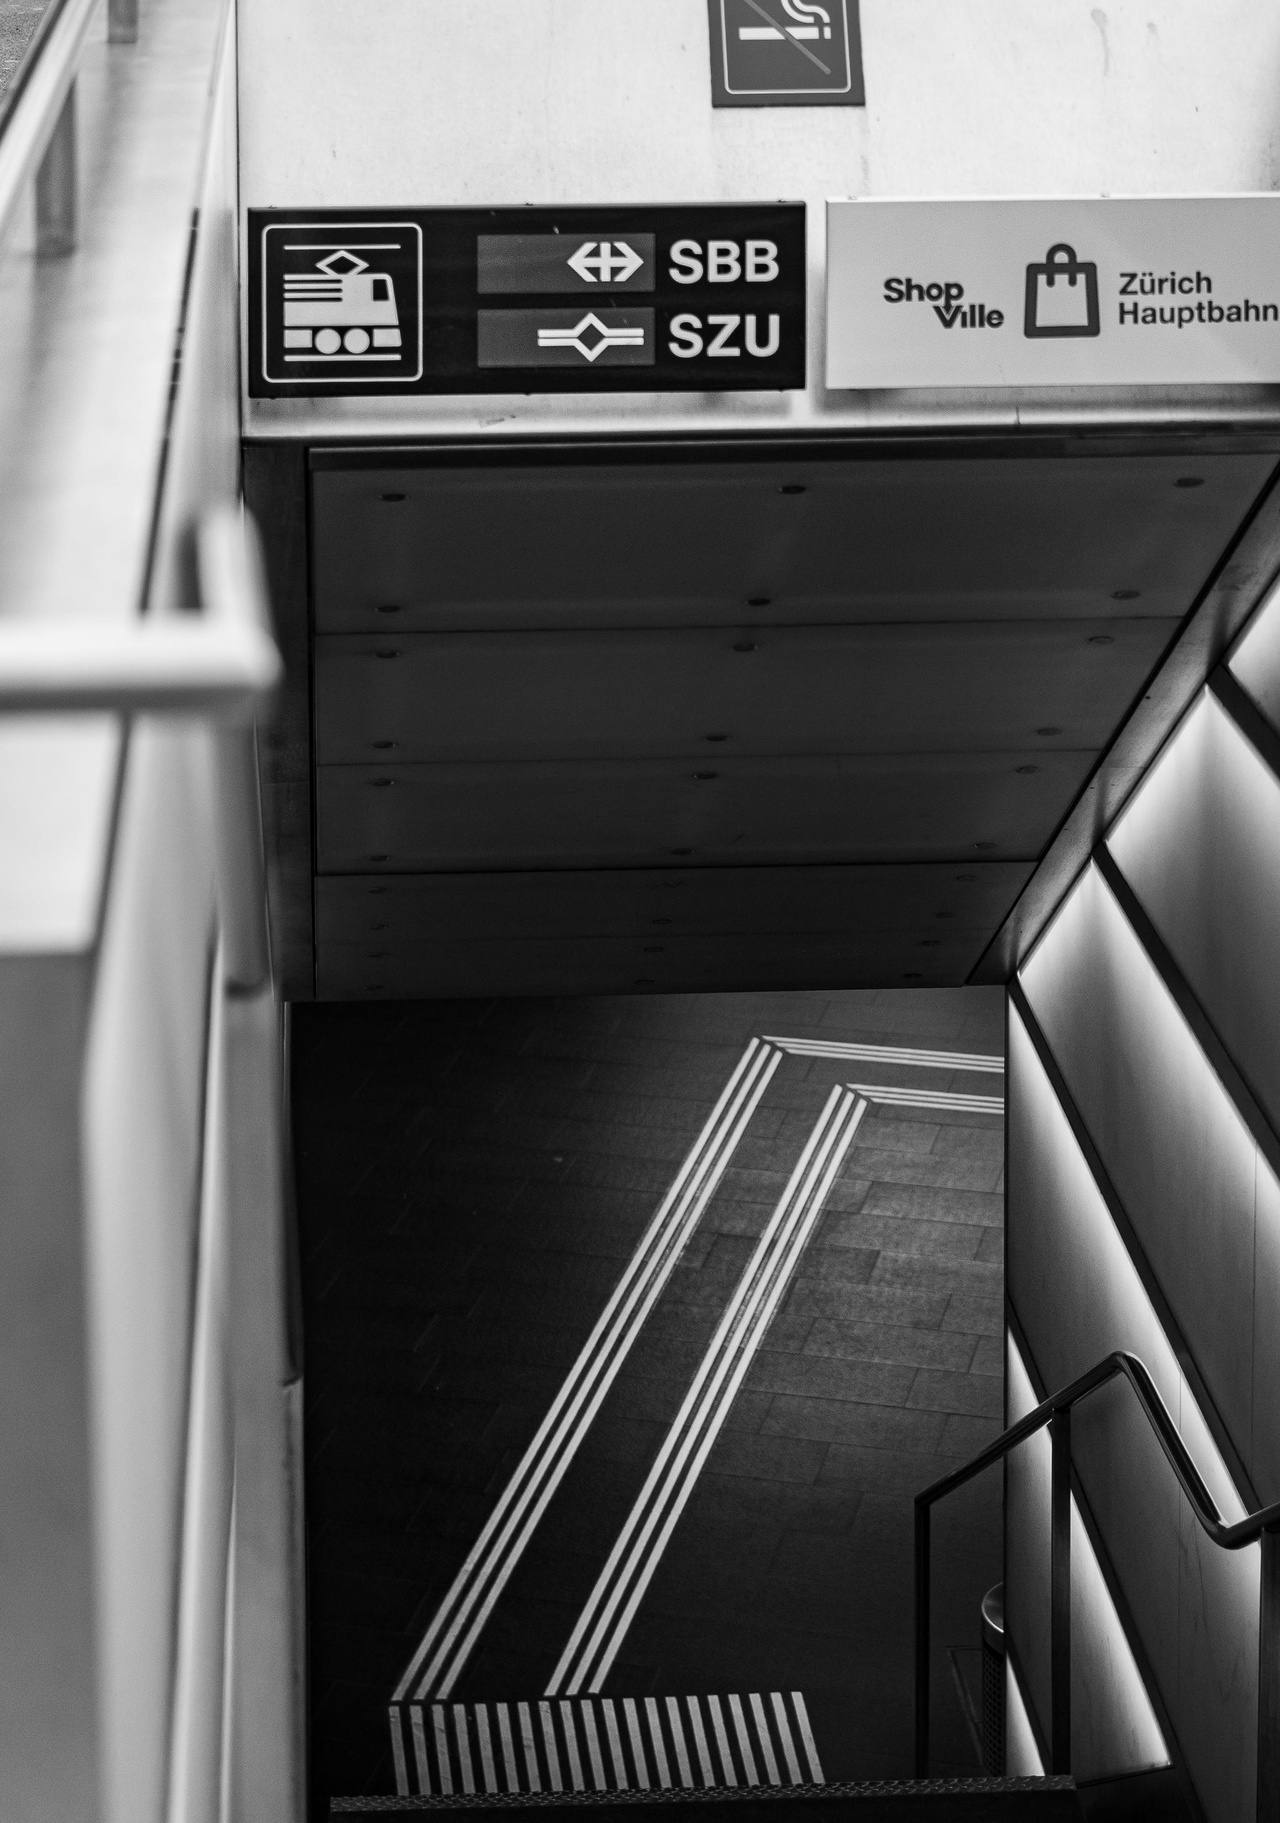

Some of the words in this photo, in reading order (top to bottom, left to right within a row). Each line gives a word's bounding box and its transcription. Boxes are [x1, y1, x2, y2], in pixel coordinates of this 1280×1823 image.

[668, 239, 780, 284] SBB
[883, 277, 965, 316] Shop
[1118, 270, 1213, 296] Zürich
[668, 313, 780, 358] SZU
[932, 303, 1005, 329] Ville
